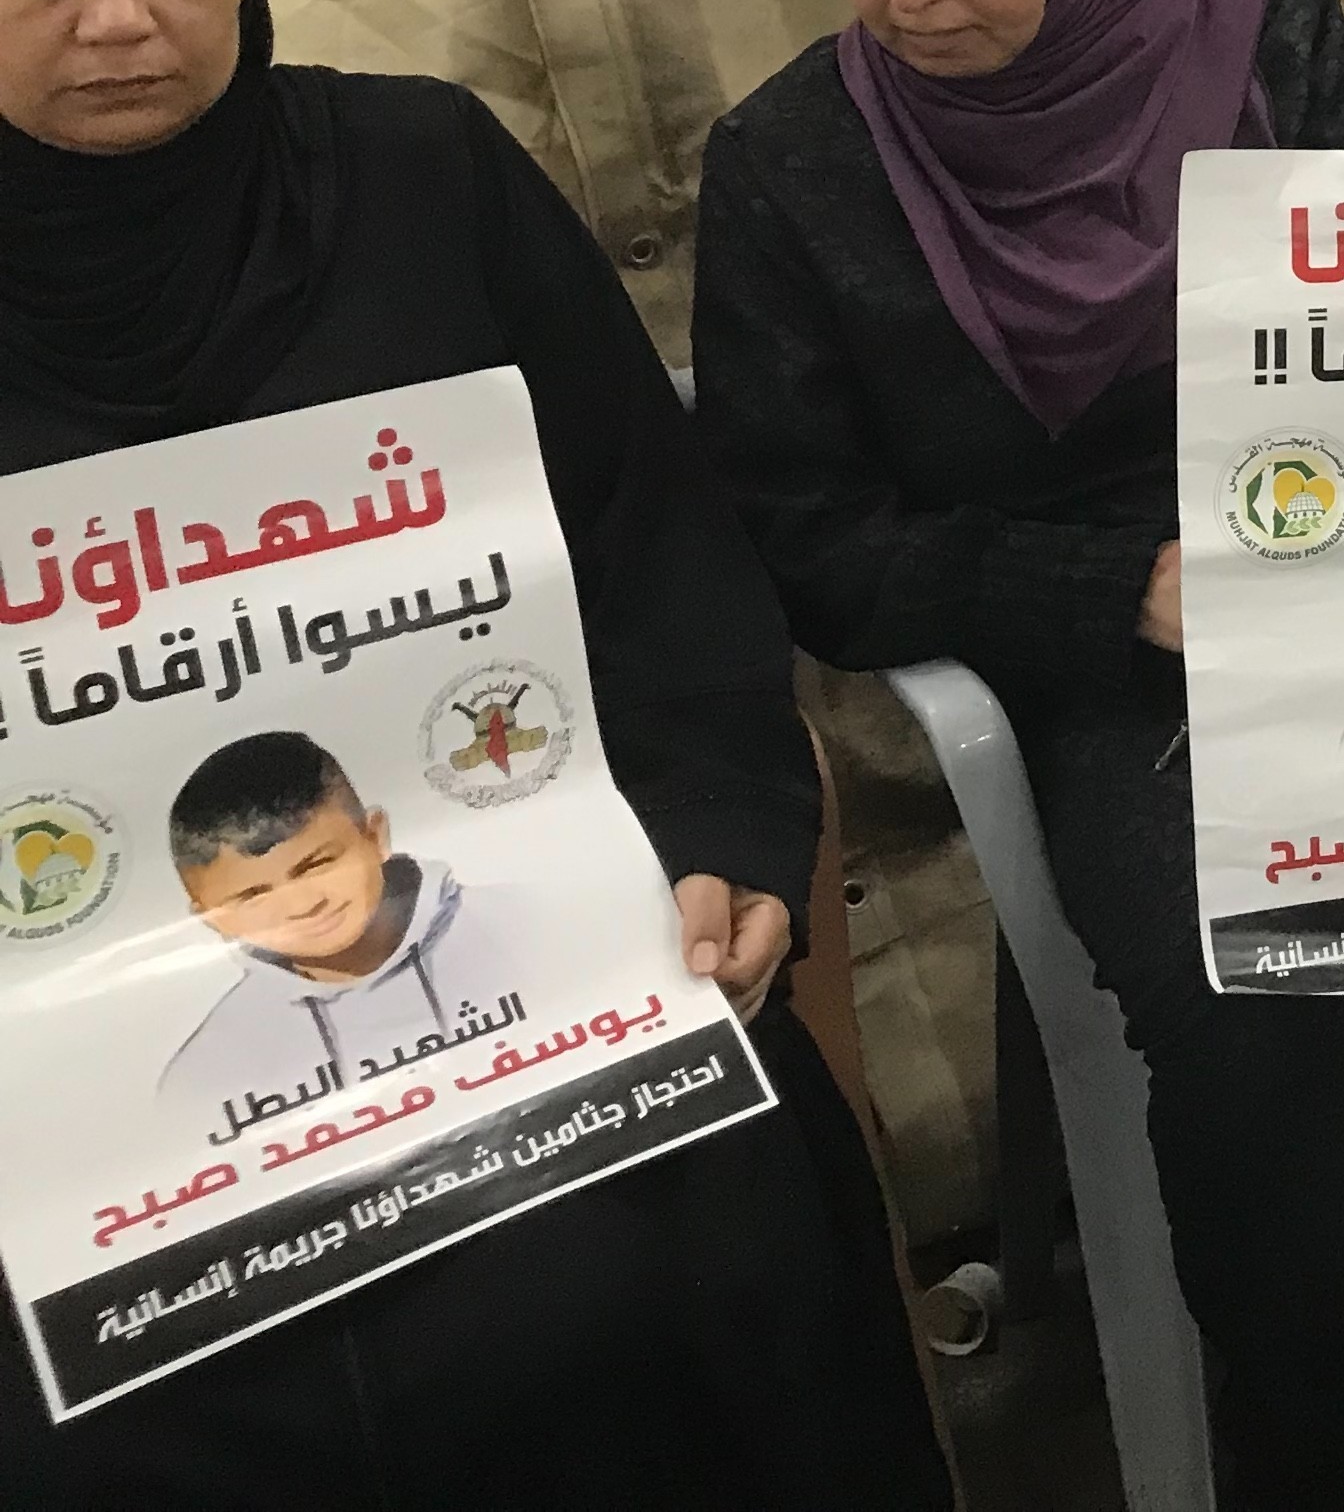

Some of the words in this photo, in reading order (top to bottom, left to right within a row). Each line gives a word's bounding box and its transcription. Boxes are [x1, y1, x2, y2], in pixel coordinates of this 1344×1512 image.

[1257, 548, 1301, 560] ALQUDS
[281, 552, 512, 674] ليسوا
[359, 990, 526, 1083] الشهيد
[455, 992, 668, 1092] يوسف
[206, 1061, 344, 1147] البطل
[261, 1083, 434, 1170] محمد
[632, 1055, 724, 1117] احتجاز
[512, 1096, 625, 1169] جثامين
[92, 1164, 239, 1247] صبح
[351, 1144, 503, 1230] شهداؤنا
[244, 1217, 347, 1283] جريمة
[97, 1259, 234, 1344] إنسانية
